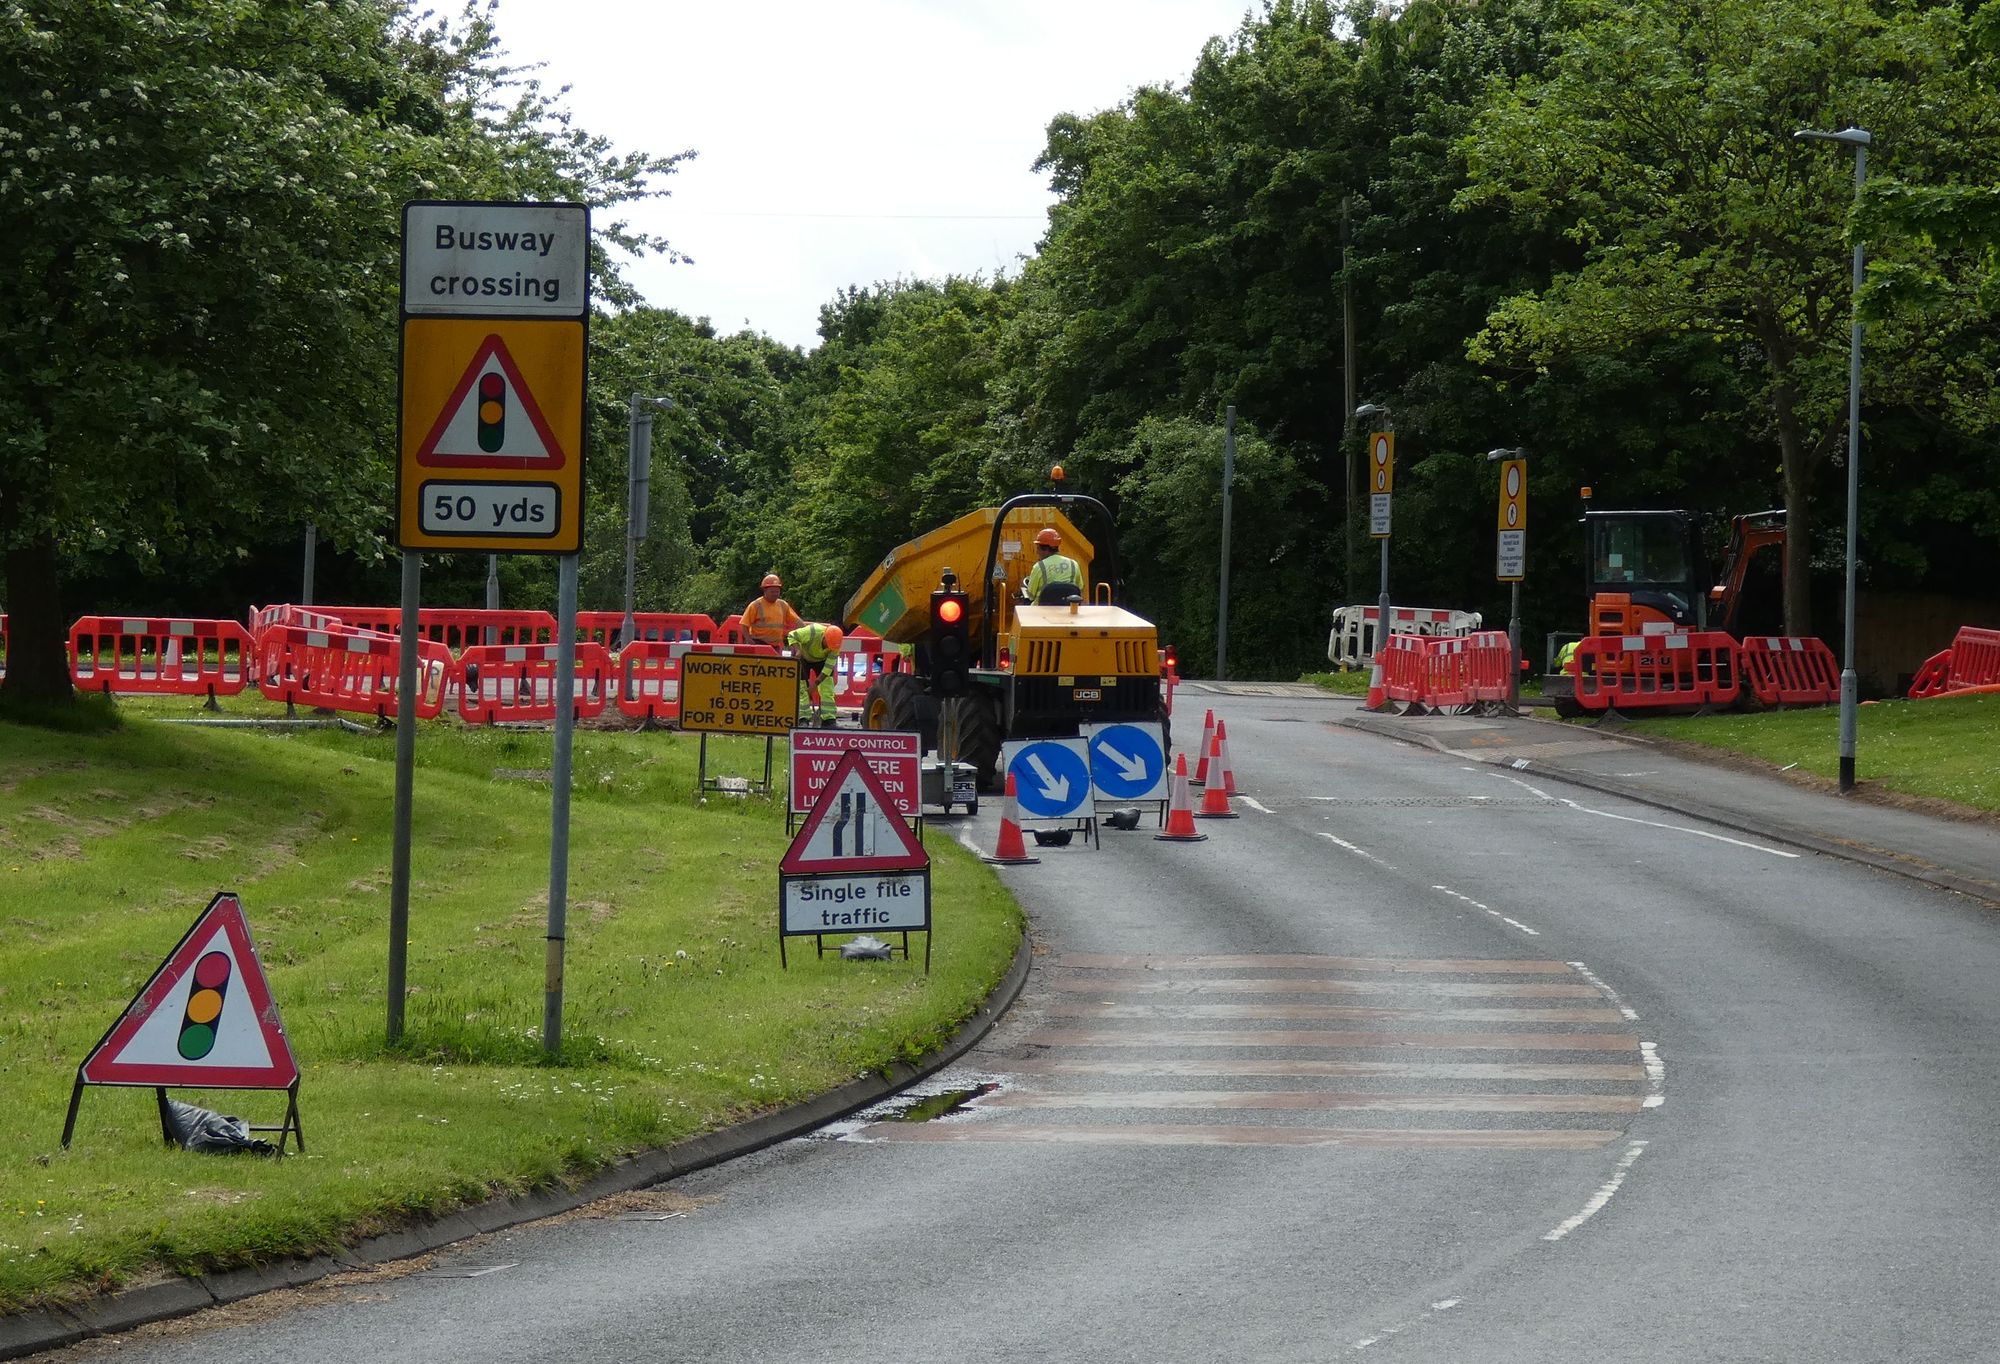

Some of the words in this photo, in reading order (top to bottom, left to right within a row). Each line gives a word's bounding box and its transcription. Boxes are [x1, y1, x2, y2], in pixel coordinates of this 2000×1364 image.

[435, 224, 554, 257] Busway
[430, 271, 560, 302] crossing
[434, 495, 476, 521] 50
[492, 497, 544, 527] yds
[686, 662, 732, 675] WORK
[739, 664, 796, 678] STARTS
[721, 681, 762, 694] HERE
[1075, 691, 1099, 699] JCB
[709, 697, 774, 712] 16.05.22
[684, 711, 715, 723] FOR
[725, 712, 734, 725] 8
[742, 714, 794, 728] WEEKS
[802, 737, 844, 747] 4-WAY
[849, 738, 907, 750] CONTROL
[868, 761, 900, 774] ERE
[800, 883, 866, 903] Single
[877, 882, 911, 898] file
[821, 908, 890, 925] traffic
